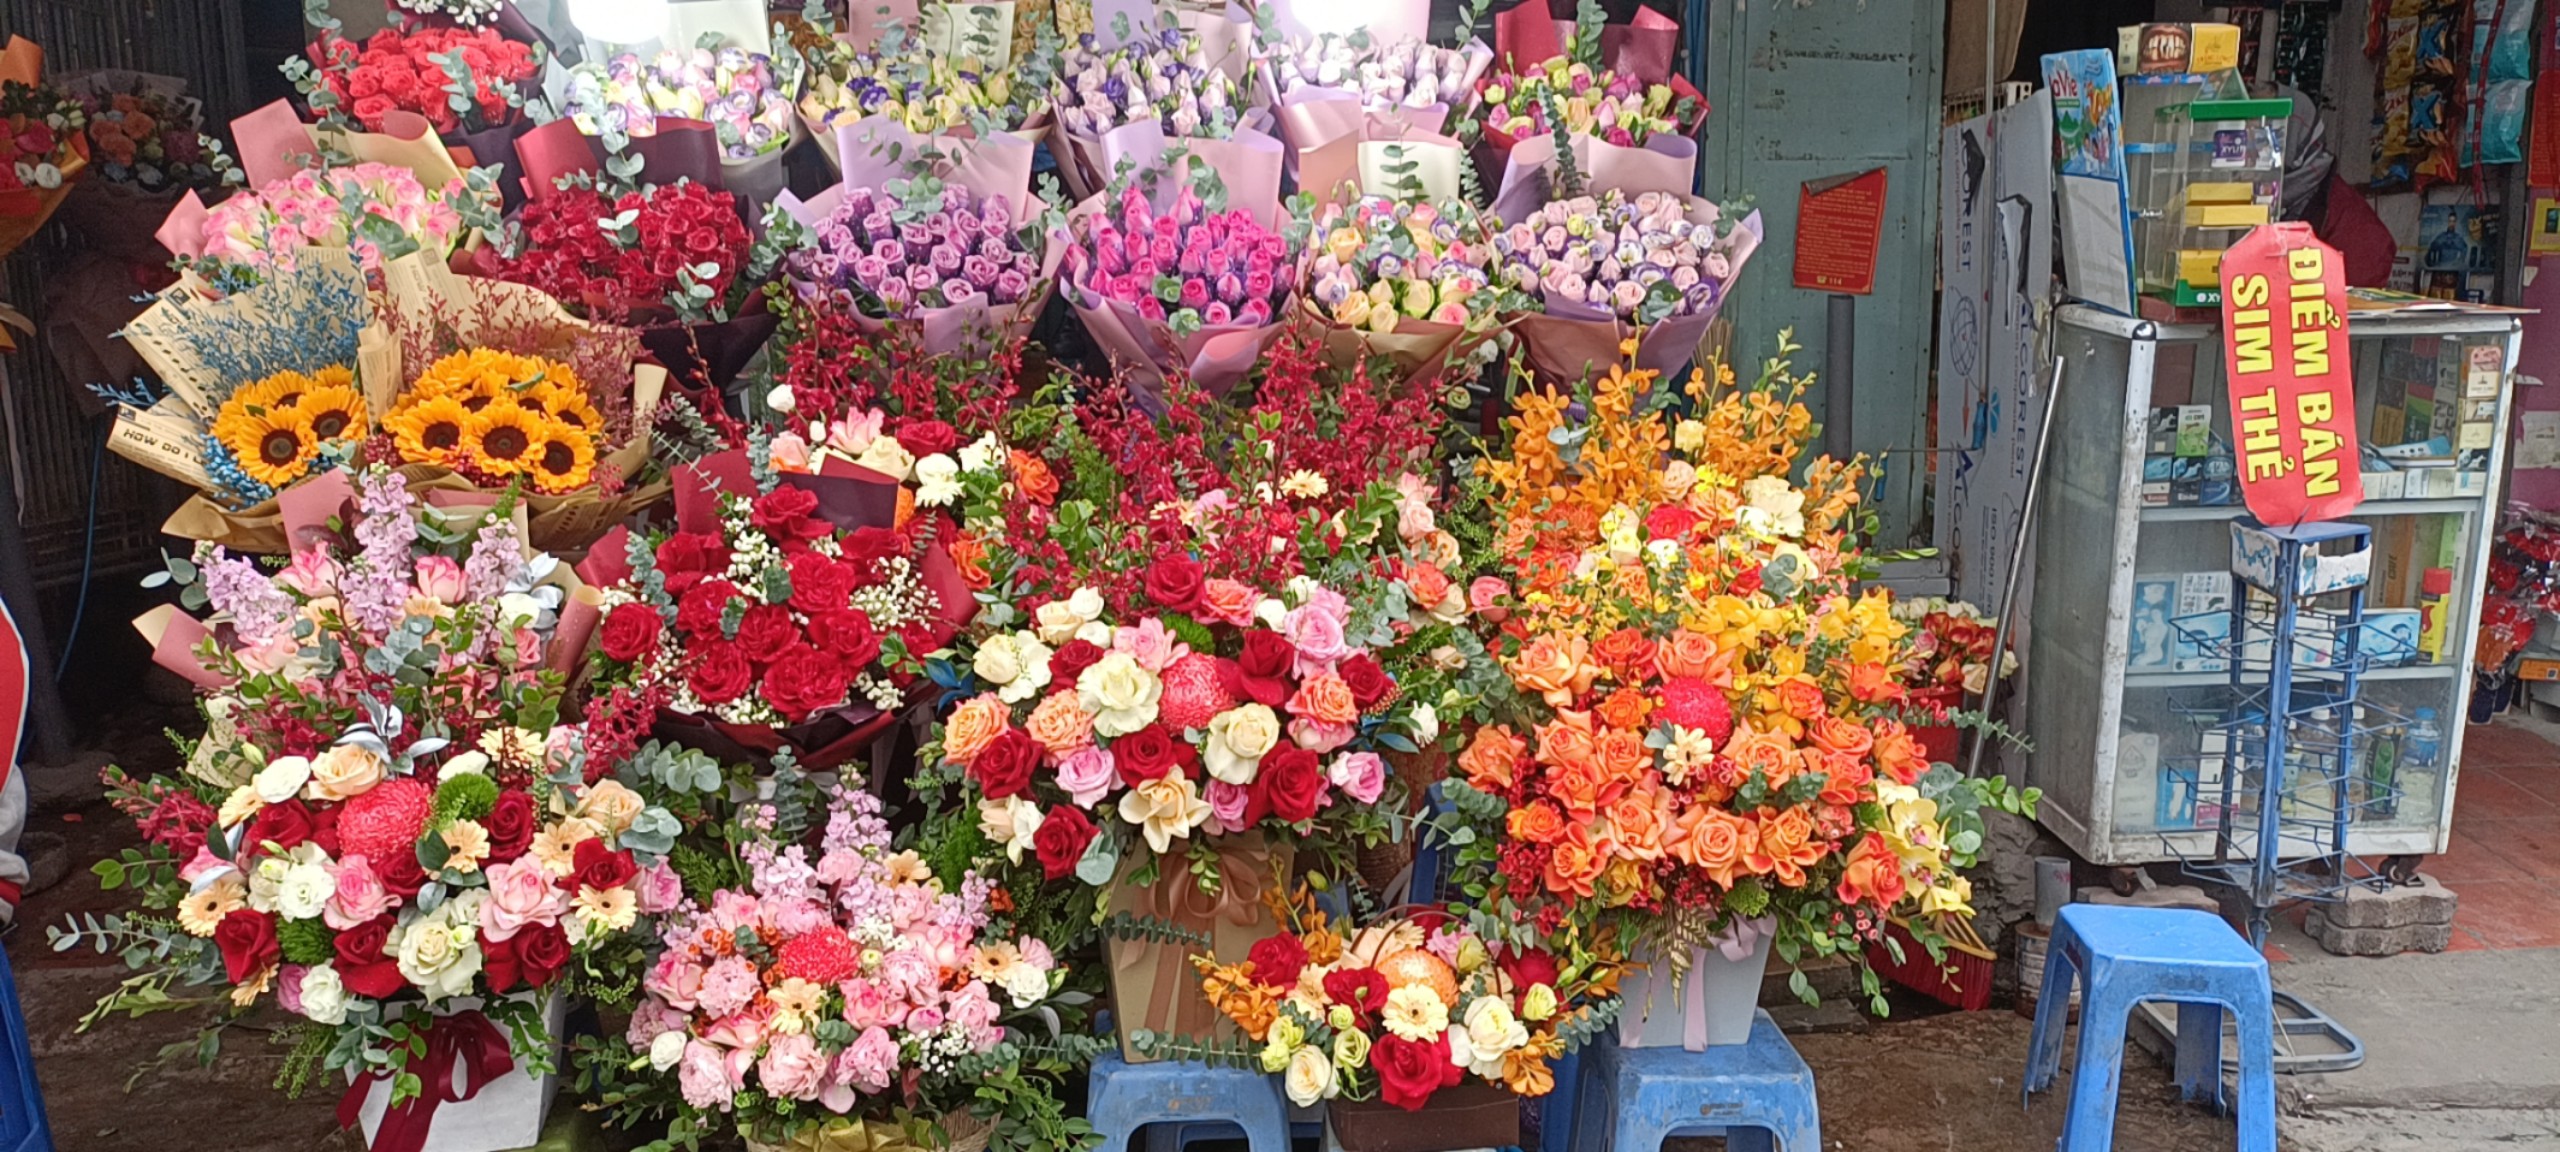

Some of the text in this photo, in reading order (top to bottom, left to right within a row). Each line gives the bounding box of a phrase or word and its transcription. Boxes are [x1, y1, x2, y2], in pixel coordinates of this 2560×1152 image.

[123, 428, 158, 446] HOW
[162, 442, 180, 455] DO
[2015, 303, 2028, 481] LCOREST
[2230, 273, 2296, 483] SIM THẺ
[2287, 247, 2345, 497] ĐIỂM BÁN
[1990, 508, 1998, 541] ISO
